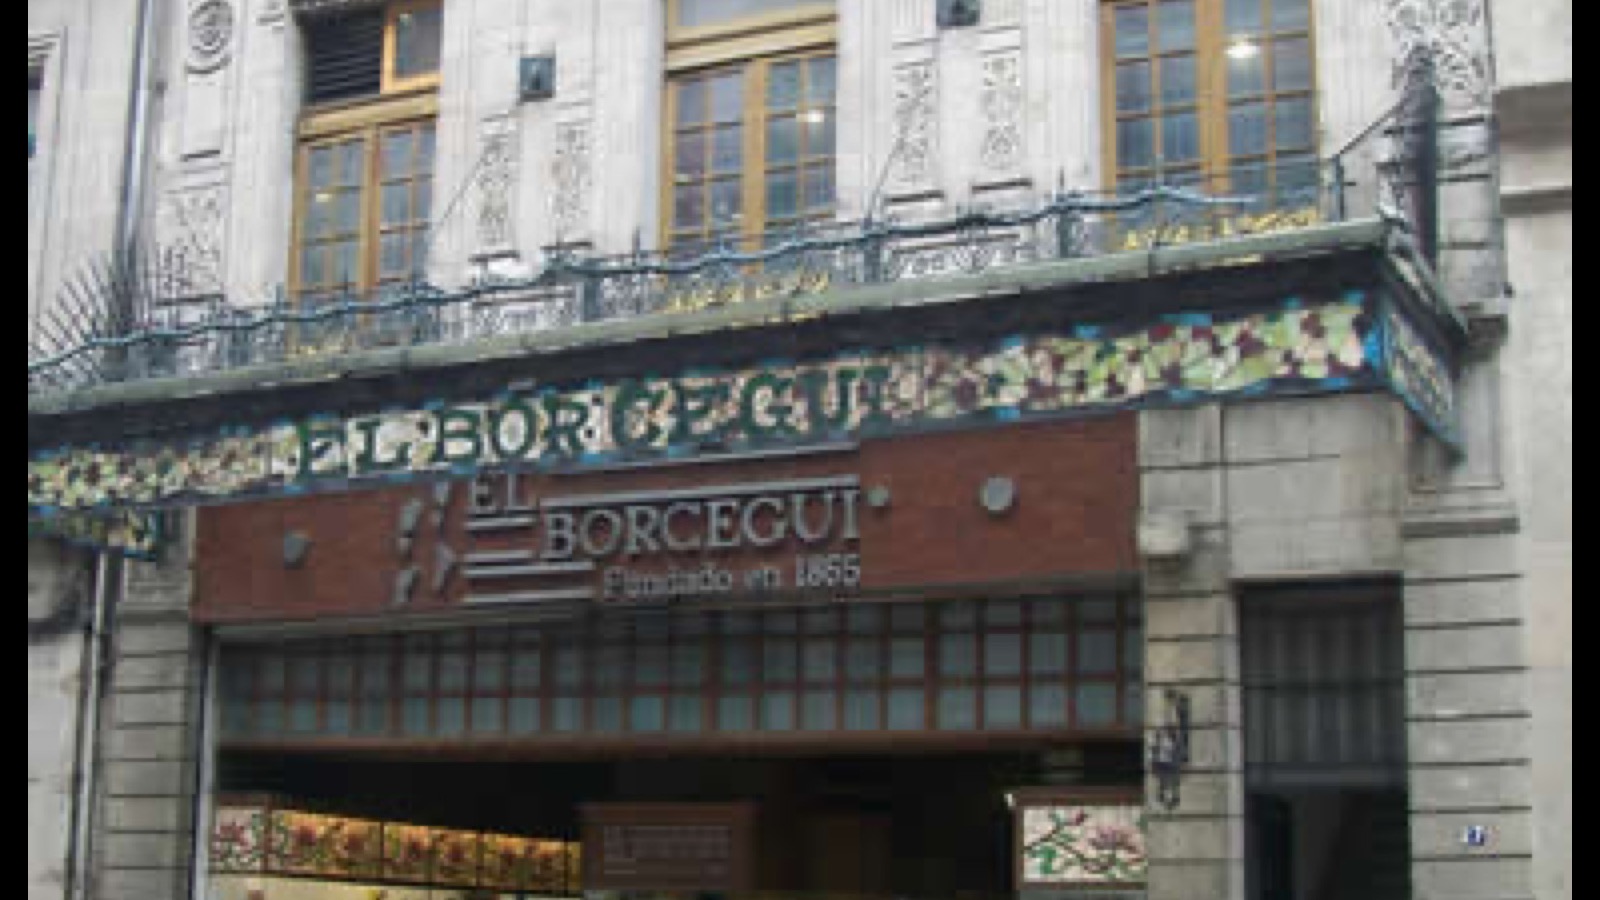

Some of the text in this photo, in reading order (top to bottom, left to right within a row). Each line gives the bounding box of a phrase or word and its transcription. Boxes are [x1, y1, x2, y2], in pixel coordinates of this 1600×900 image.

[298, 367, 893, 476] EL BORCEGUI
[469, 470, 536, 513] EL
[542, 489, 861, 560] BORCEGUI
